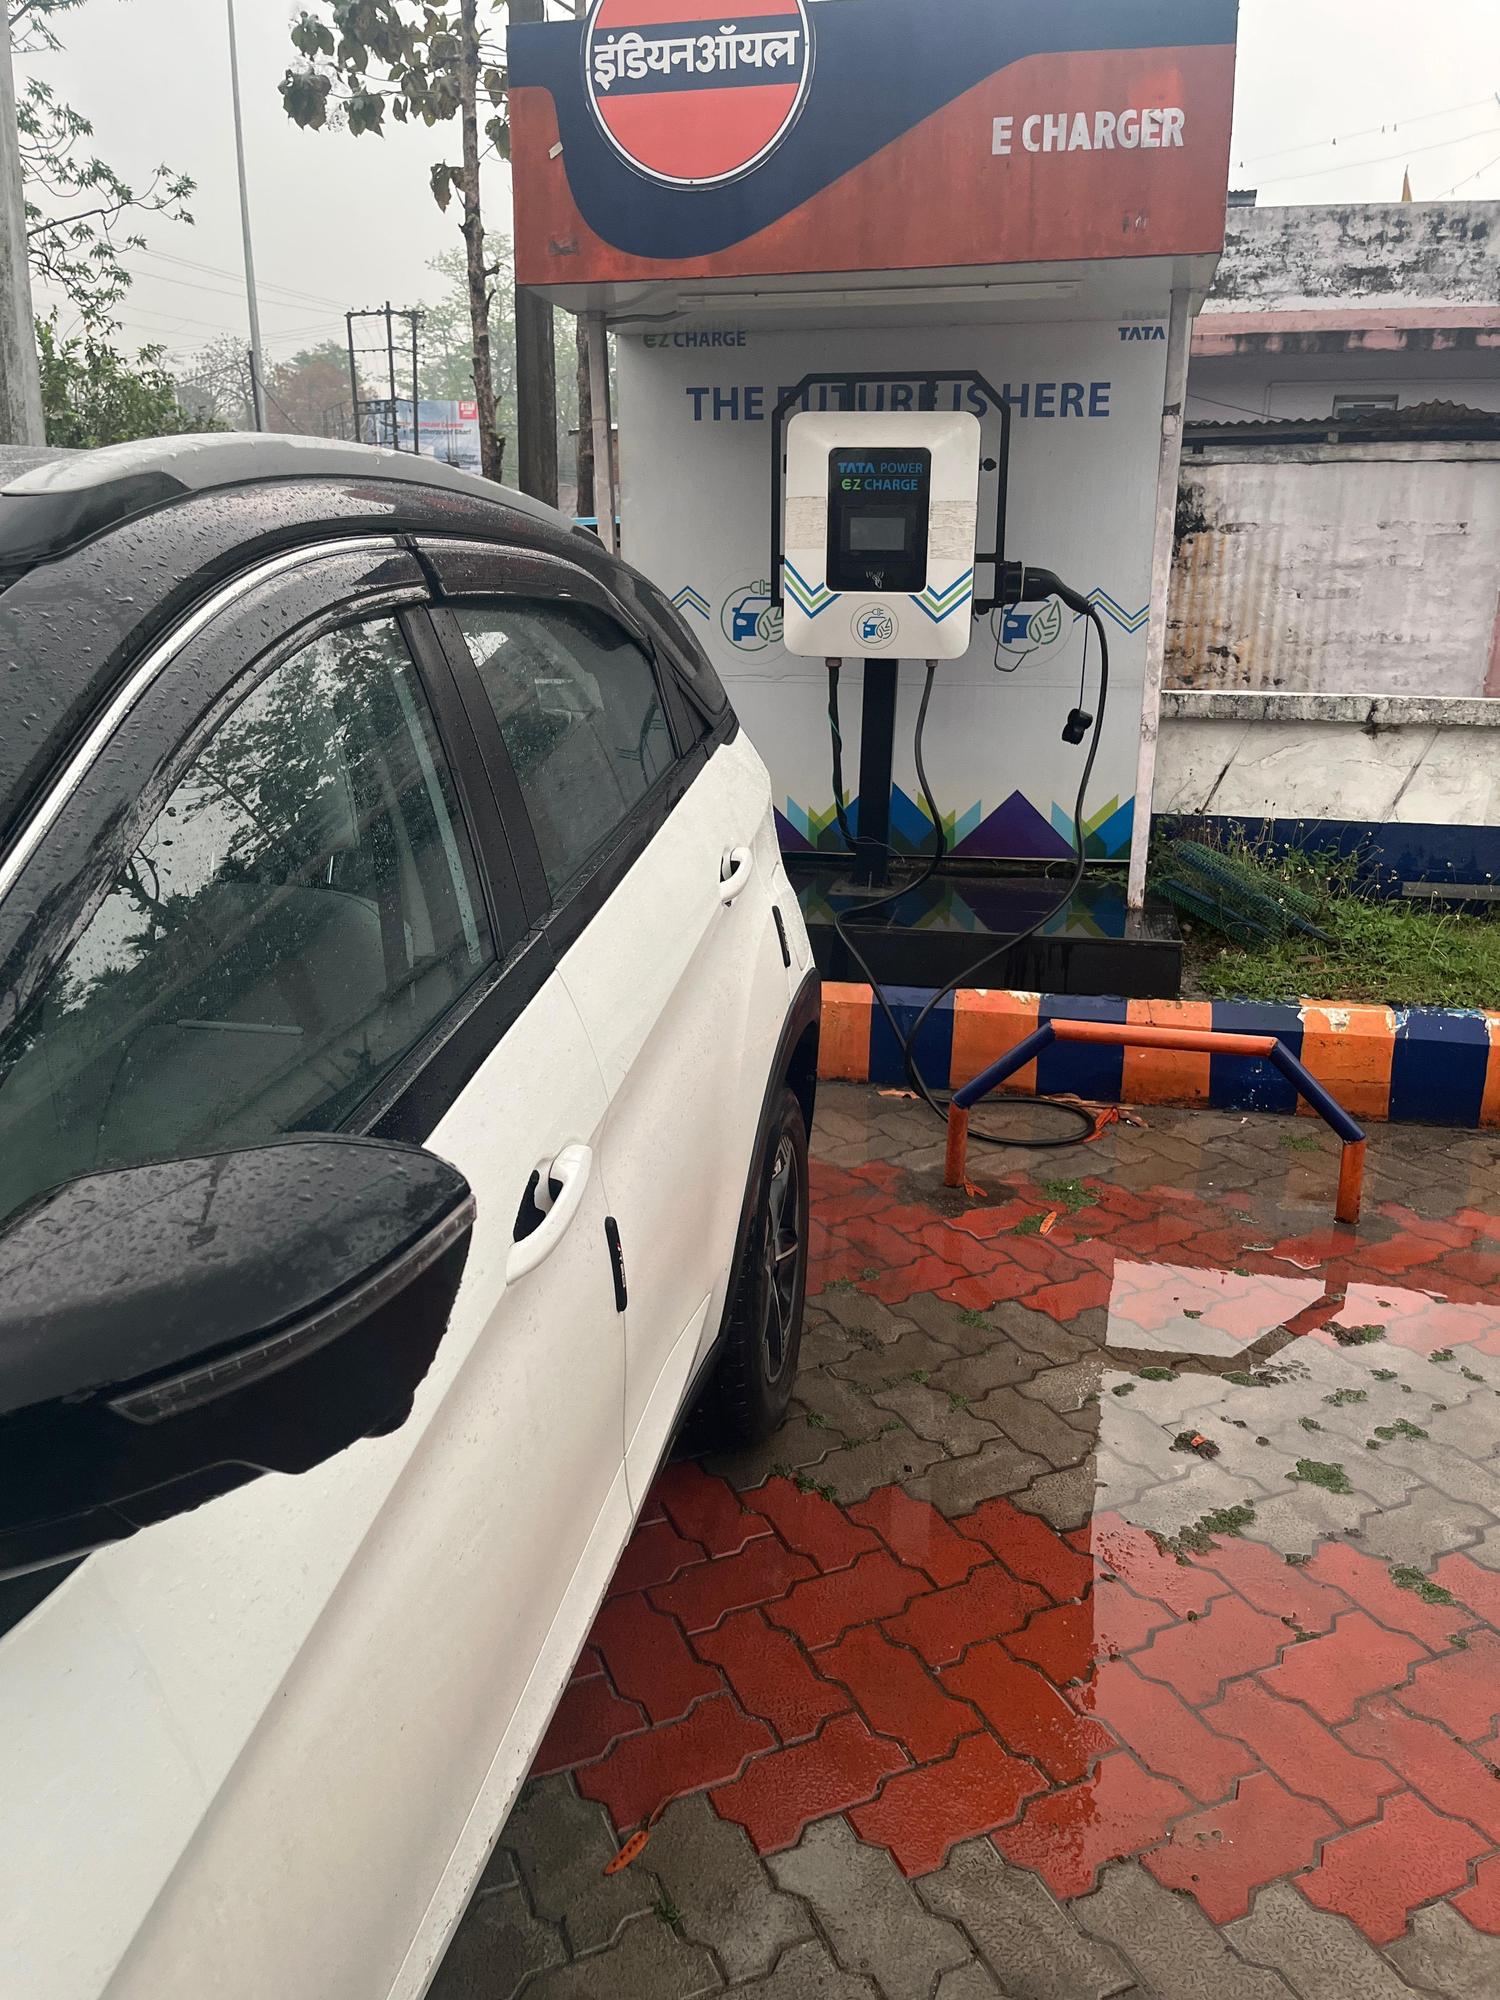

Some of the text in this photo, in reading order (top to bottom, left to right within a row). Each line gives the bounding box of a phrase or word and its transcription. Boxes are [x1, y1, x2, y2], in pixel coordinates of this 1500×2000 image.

[594, 24, 800, 91] इंडियनऑयल
[992, 107, 1185, 155] E CHARGER
[673, 330, 747, 348] CHARGE
[1118, 326, 1166, 341] TATA
[686, 386, 764, 422] THE
[953, 382, 988, 418] IS
[1003, 382, 1111, 418] HERE
[837, 462, 923, 474] TATA POWER
[841, 478, 919, 491] EZ CHARGE
